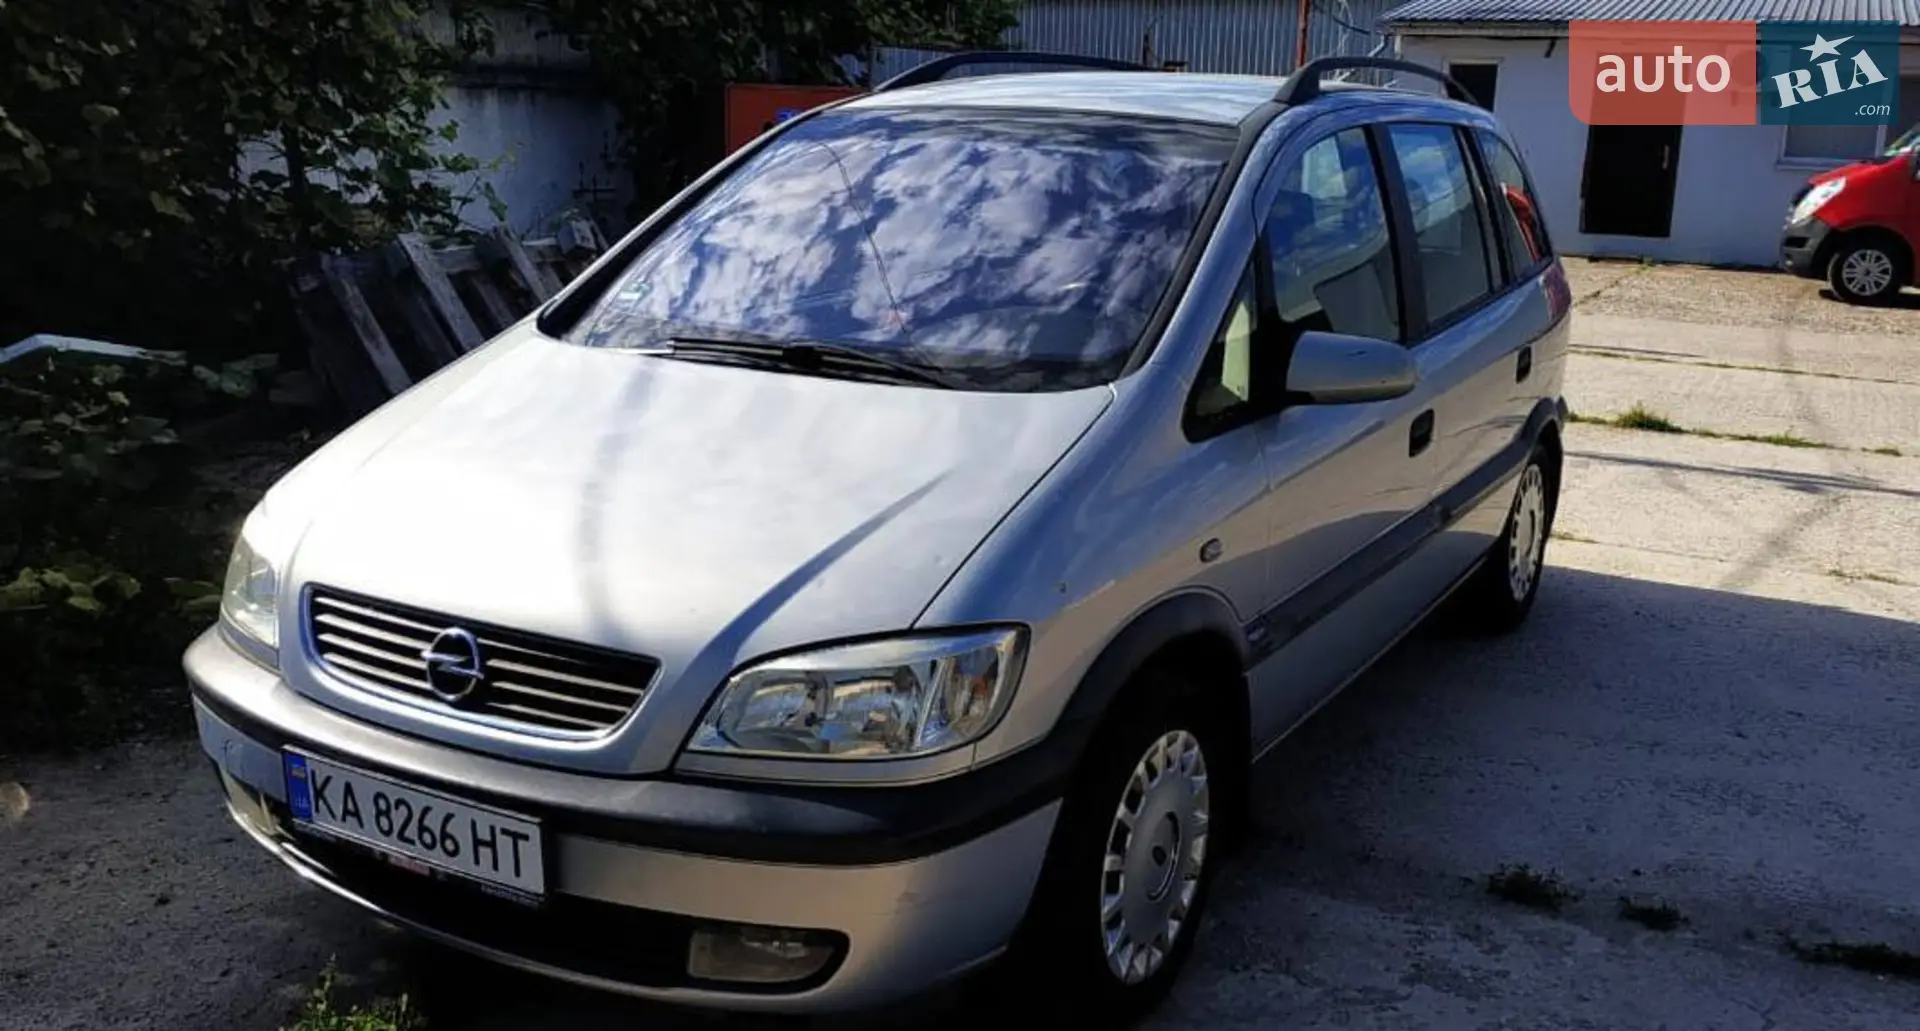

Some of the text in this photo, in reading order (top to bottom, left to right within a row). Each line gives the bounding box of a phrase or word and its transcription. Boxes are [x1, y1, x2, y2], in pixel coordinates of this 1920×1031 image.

[310, 769, 364, 829] KA
[372, 792, 461, 858] 8266
[470, 818, 530, 878] HT
